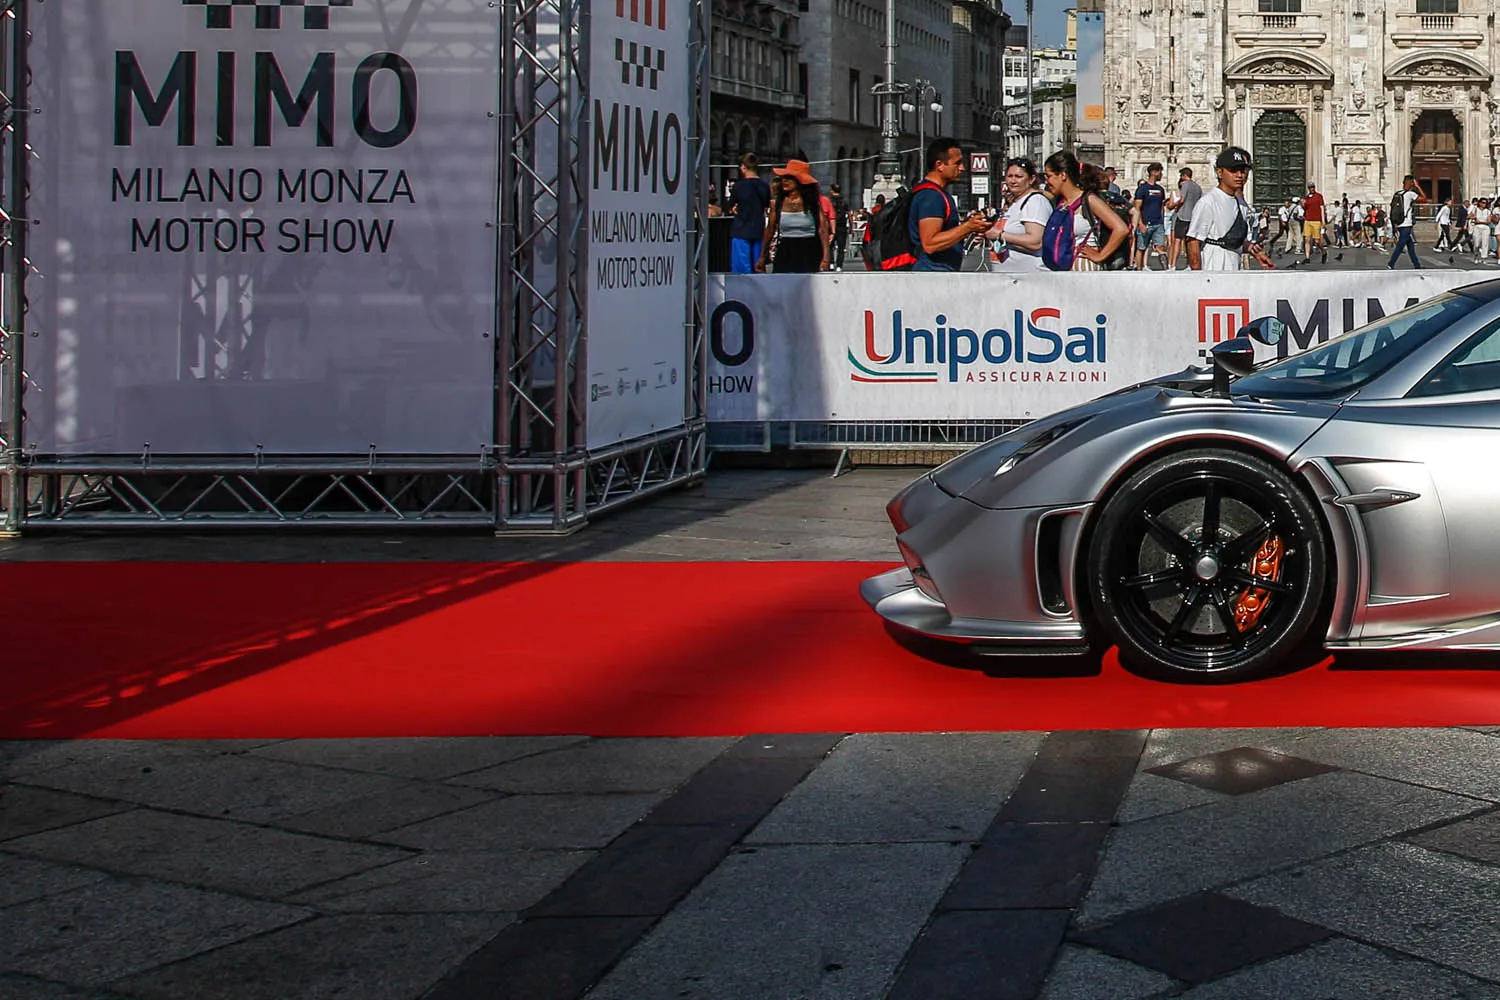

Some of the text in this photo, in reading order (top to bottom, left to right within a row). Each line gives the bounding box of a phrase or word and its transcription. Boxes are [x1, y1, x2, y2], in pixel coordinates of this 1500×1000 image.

[113, 50, 418, 149] MIMO
[593, 98, 682, 196] MIMO
[973, 157, 988, 169] M
[111, 167, 416, 204] MILANO MONZA
[131, 217, 394, 253] MOTOR SHOW
[591, 210, 681, 243] MILANO MONZA
[597, 255, 675, 291] MOTOR SHOW
[864, 307, 1107, 383] UnipolSai
[709, 375, 754, 394] HOW
[965, 371, 1108, 383] ASSICURAZIONI
